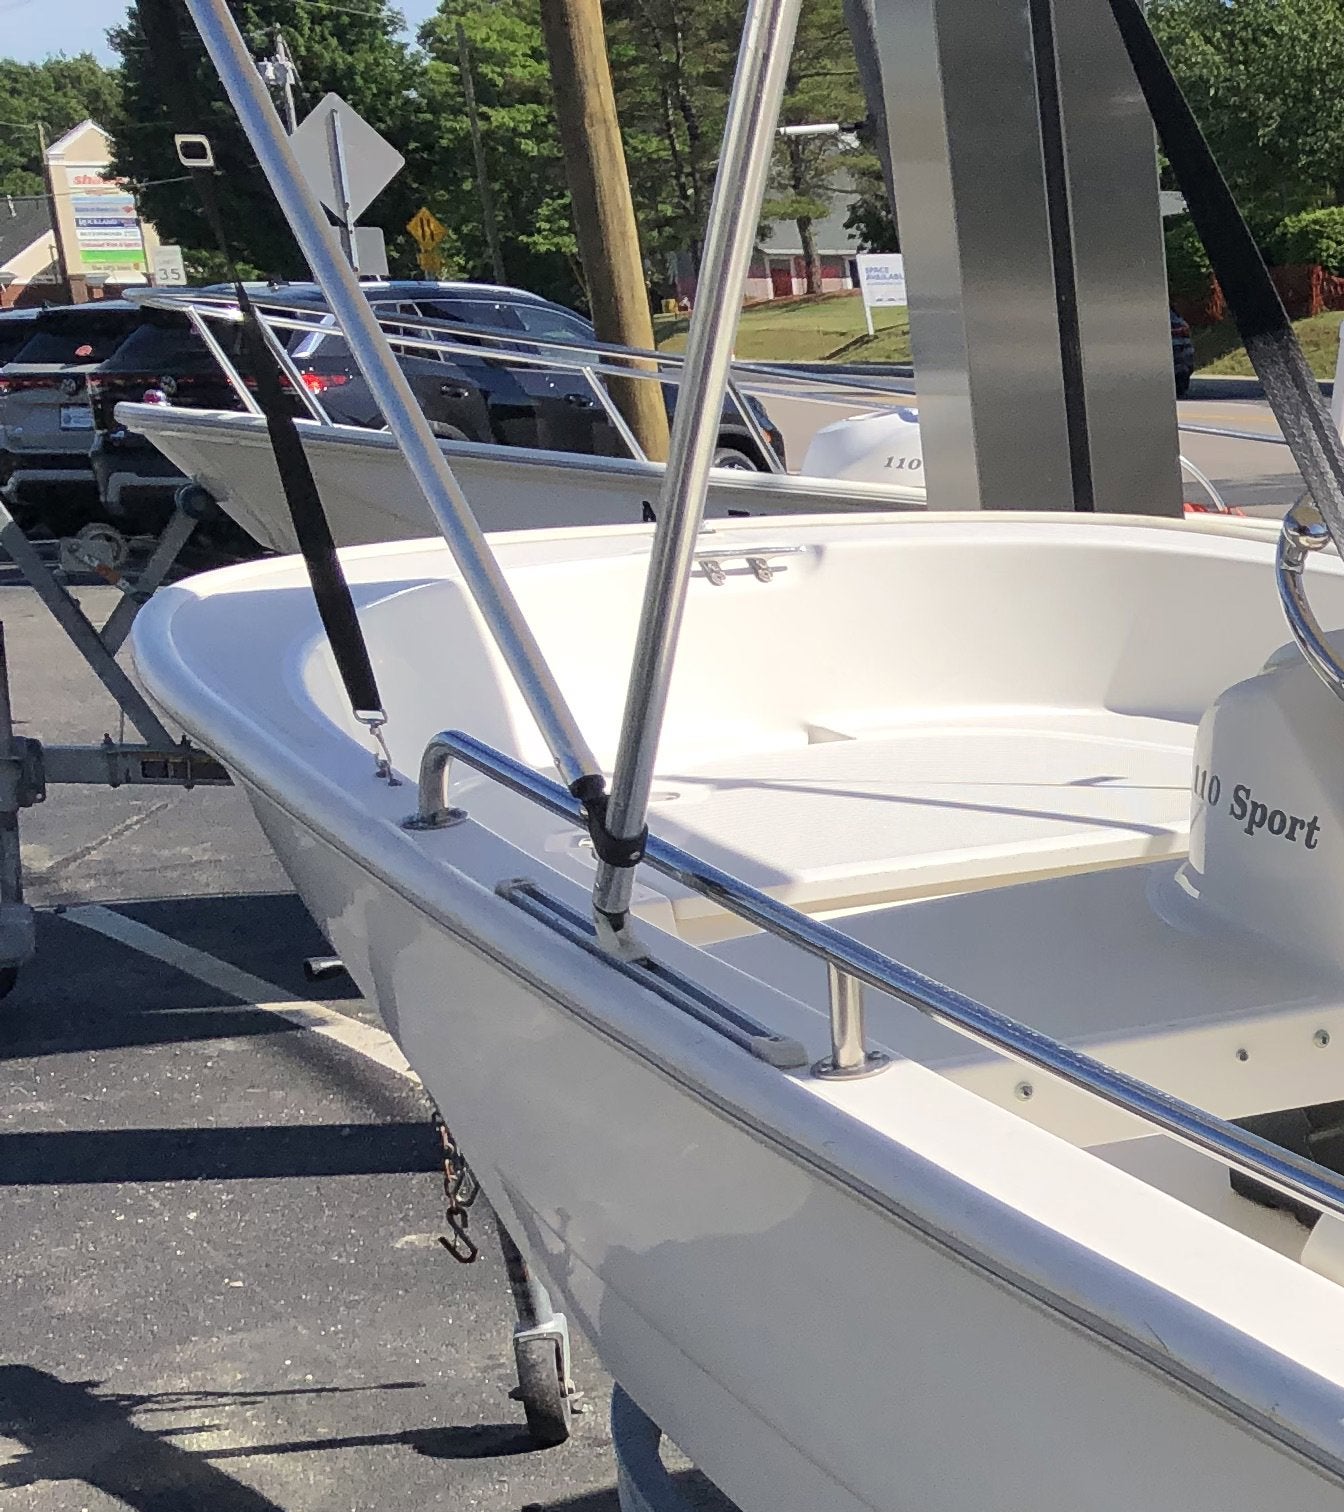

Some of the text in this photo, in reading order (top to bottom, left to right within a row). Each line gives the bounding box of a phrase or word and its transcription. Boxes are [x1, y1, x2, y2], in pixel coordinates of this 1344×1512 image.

[158, 268, 181, 281] 35
[865, 273, 905, 281] AVAILABL
[883, 455, 922, 471] 110
[1229, 784, 1321, 850] Sport
